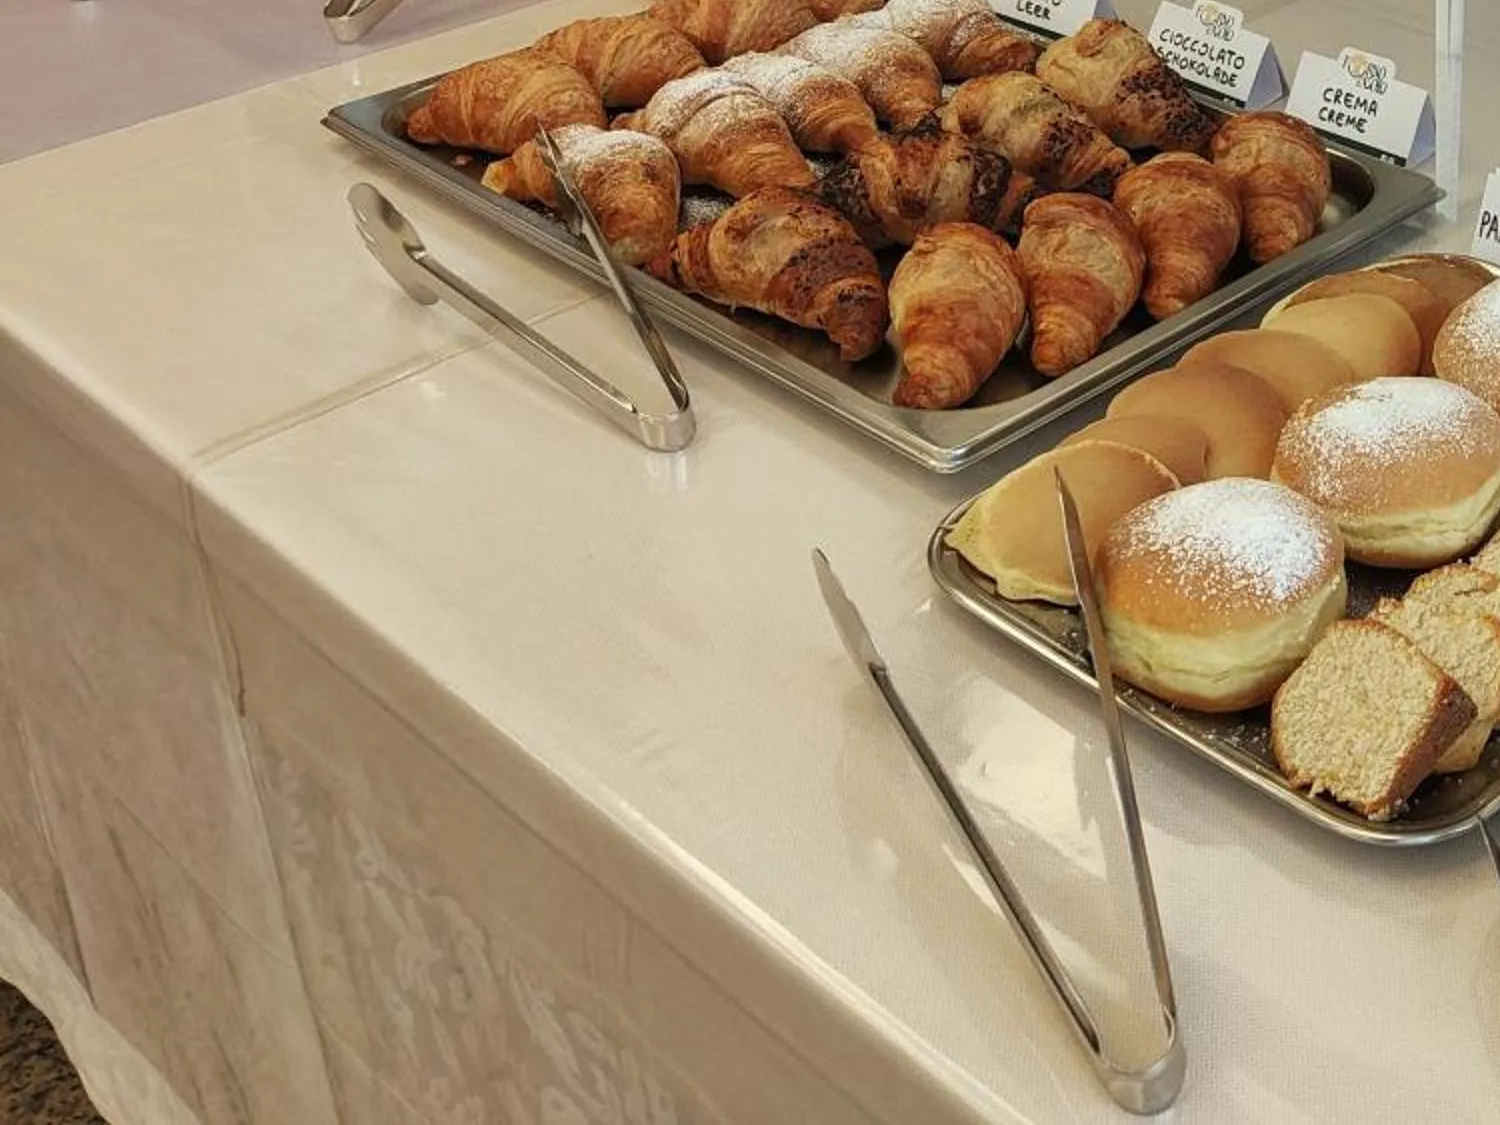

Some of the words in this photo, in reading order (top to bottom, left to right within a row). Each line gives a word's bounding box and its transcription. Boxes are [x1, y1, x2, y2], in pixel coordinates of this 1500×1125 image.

[1016, 0, 1051, 21] LEER
[1159, 27, 1245, 70] CIOCCOLATO
[1156, 46, 1238, 88] SCHOKOLADE
[1323, 87, 1378, 117] CREMA
[1318, 106, 1367, 134] CREME
